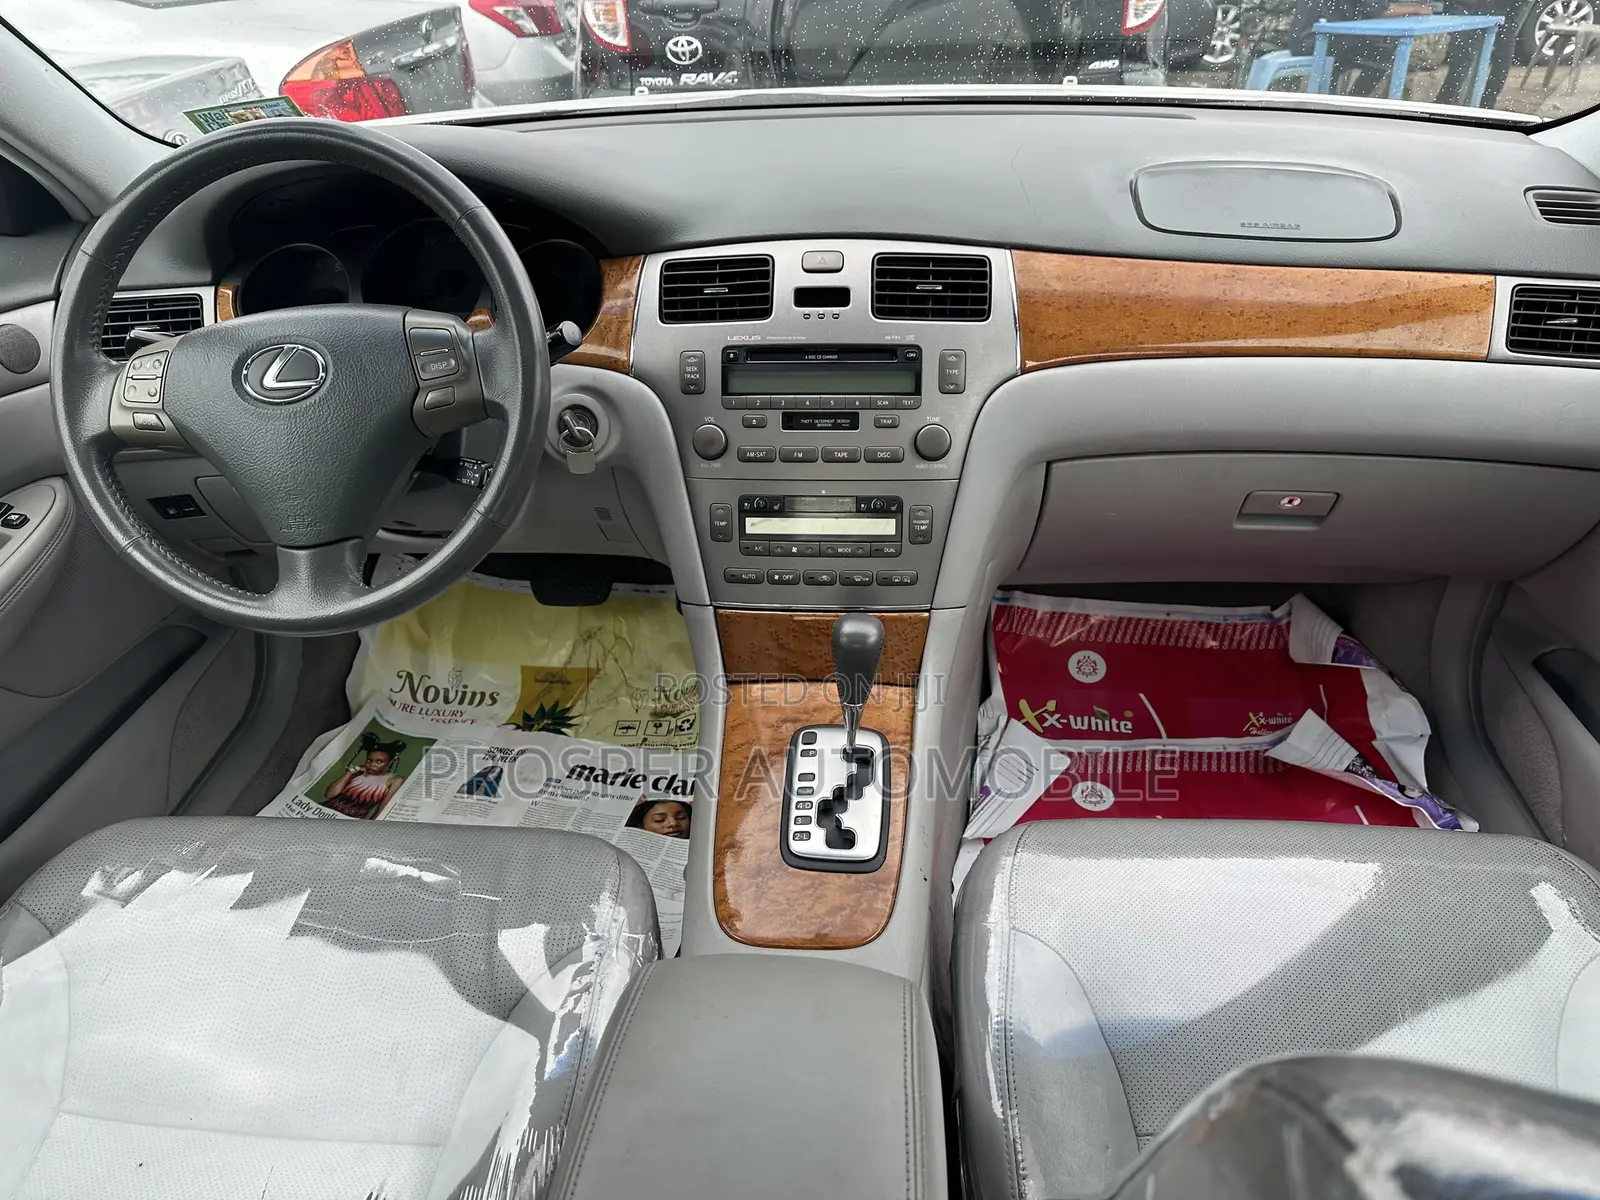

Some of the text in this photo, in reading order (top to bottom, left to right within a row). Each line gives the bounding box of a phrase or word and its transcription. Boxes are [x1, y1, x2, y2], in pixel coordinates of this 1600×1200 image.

[640, 77, 674, 86] TOYOTA
[430, 361, 447, 371] DISP
[390, 669, 500, 707] Novins
[418, 707, 467, 718] LUXURY
[487, 747, 515, 756] SONGS
[482, 753, 518, 763] THE WEEK
[566, 764, 647, 789] marie
[291, 795, 313, 813] Lady
